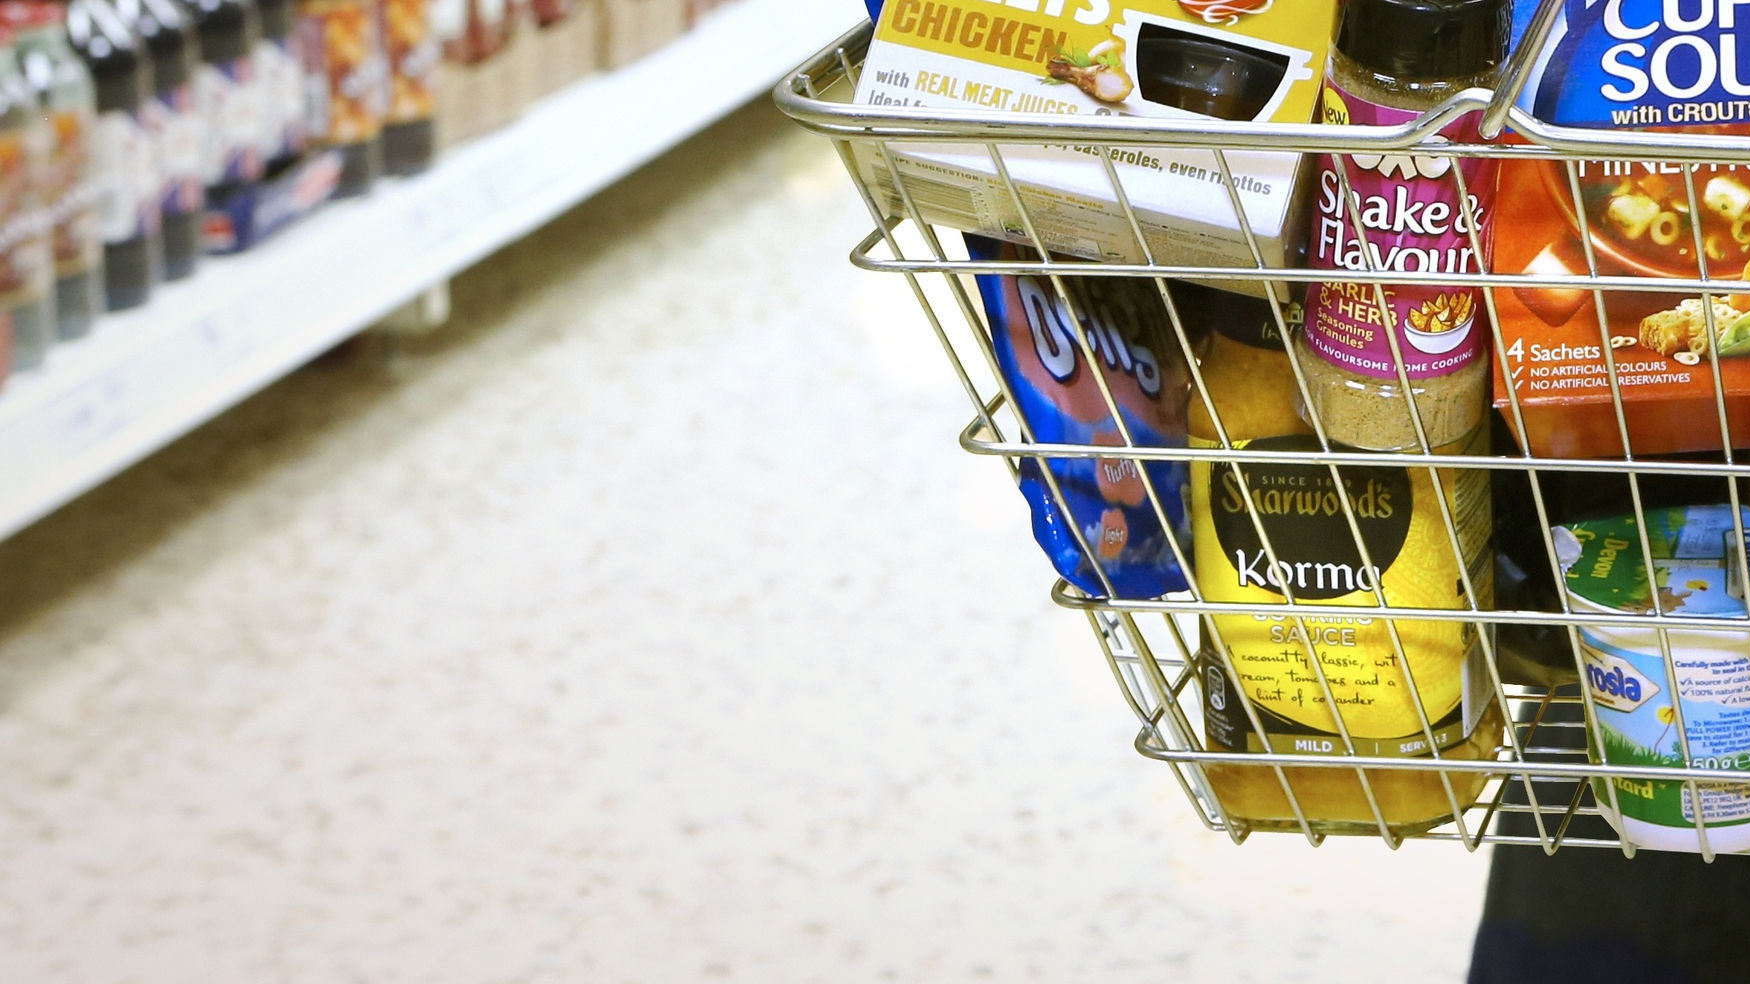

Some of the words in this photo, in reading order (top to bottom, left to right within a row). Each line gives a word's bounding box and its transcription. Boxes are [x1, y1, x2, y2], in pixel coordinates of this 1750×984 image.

[876, 68, 910, 89] with
[914, 70, 958, 100] REAL
[962, 80, 1013, 111] MEAT
[1612, 105, 1662, 125] with
[1073, 145, 1163, 172] caseroles,
[1169, 161, 1206, 181] even
[1209, 171, 1272, 196] riottos
[1318, 216, 1475, 273] Flavour
[1316, 320, 1364, 350] Granules
[1317, 307, 1374, 342] Seasoning
[1315, 338, 1389, 372] FLAVOURSOME
[1431, 349, 1473, 371] COOKING
[1506, 337, 1525, 363] 4
[1530, 344, 1601, 362] Sachets
[1530, 366, 1552, 377] NO
[1552, 363, 1609, 377] ARTIFICIAL
[1530, 379, 1552, 390] NO
[1552, 377, 1609, 390] ARTIFICIAL
[1617, 373, 1691, 386] RESERVATIVES
[1261, 475, 1306, 486] SINCE
[1221, 471, 1393, 519] Sarwod's
[1235, 548, 1385, 592] Korma
[1591, 539, 1629, 579] Devon
[1271, 625, 1357, 647] SAUCE
[1241, 650, 1308, 670] coconutty
[1318, 651, 1365, 670] lassic,
[1374, 655, 1398, 668] wit
[1239, 672, 1280, 687] ream,
[1285, 669, 1347, 686] tomoes
[1355, 673, 1379, 686] and
[1586, 662, 1642, 703] rosia
[1256, 688, 1285, 703] hint
[1291, 689, 1305, 707] of
[1312, 695, 1375, 706] coander
[1295, 739, 1333, 753] MILD
